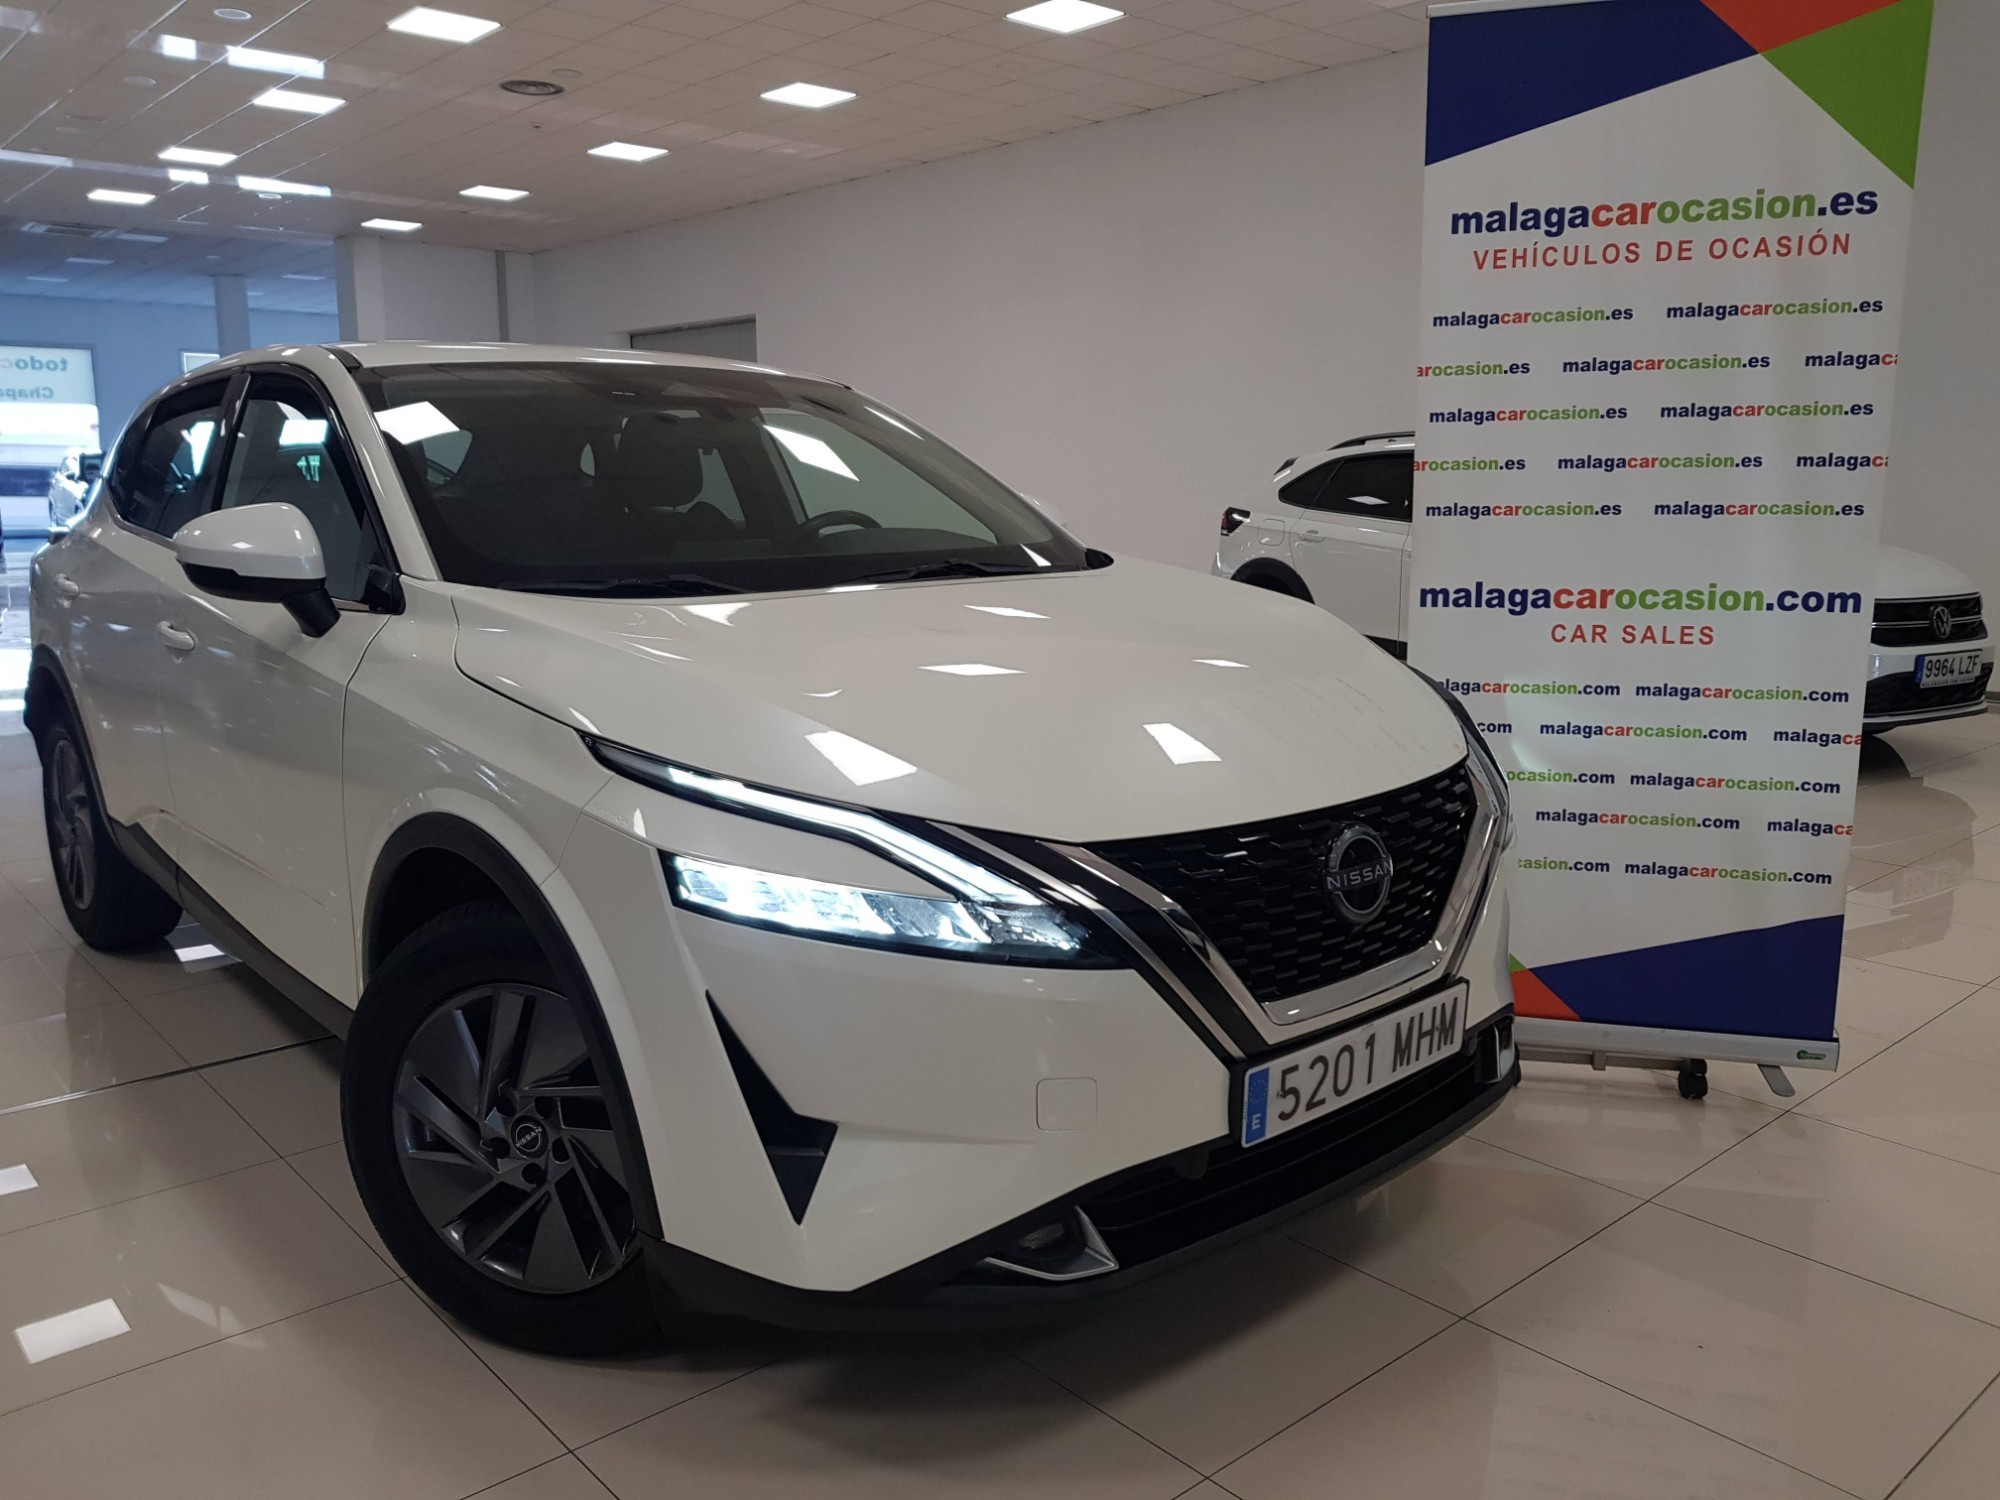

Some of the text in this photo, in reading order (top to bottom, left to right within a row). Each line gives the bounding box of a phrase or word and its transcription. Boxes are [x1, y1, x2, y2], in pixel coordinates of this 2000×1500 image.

[1451, 189, 1878, 237] malagacarocasion.es
[1474, 228, 1849, 270] VEHÍCULOS DE OCASIÓN
[1433, 307, 1633, 329] malagacarocasion.es
[1667, 299, 1883, 320] malagacarocasion.es
[1563, 354, 1770, 375] malagacarocasion.es
[1430, 406, 1627, 425] malagacarocasion.es
[1661, 401, 1873, 421] malagacarocasion.es
[1558, 454, 1762, 472] malagacarocasion.es
[1426, 502, 1621, 520] malagacarocasion.es
[1655, 501, 1864, 519] malagacarocasion.es
[1420, 581, 1861, 616] malagacarocasion.com
[1551, 624, 1713, 645] CAR SALES
[1925, 655, 1980, 678] 9964 LZF
[1636, 683, 1849, 702] malagacarocasion.com
[1540, 722, 1747, 741] malagacarocasion.com
[1630, 773, 1840, 794] malagacarocasion.com
[1536, 809, 1739, 829] malagacarocasion.com
[1326, 861, 1392, 889] NISSAN
[1625, 862, 1832, 884] malagacarocasion.com
[1278, 1033, 1377, 1122] 5201
[1392, 997, 1459, 1073] MHM
